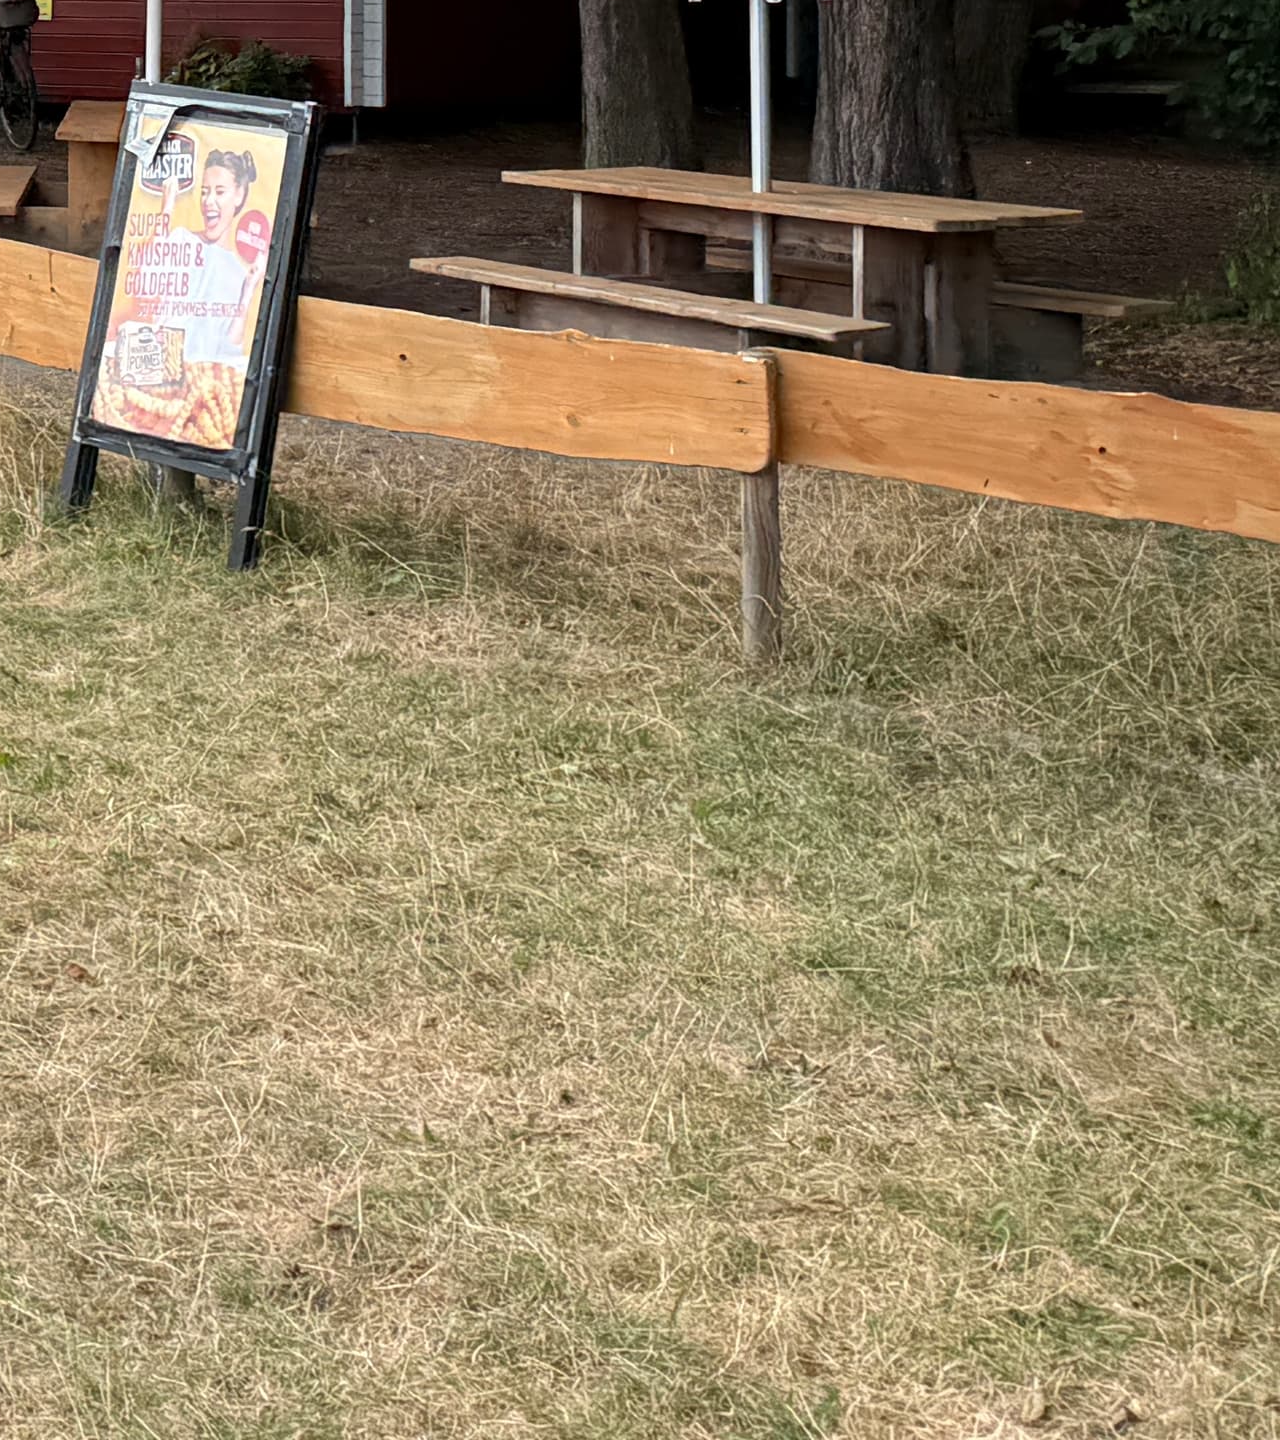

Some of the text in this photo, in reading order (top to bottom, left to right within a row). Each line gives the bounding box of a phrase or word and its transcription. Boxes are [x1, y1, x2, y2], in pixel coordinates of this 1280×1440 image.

[129, 212, 171, 237] SUPER
[194, 242, 205, 267] &
[124, 270, 190, 297] GOLDGELB
